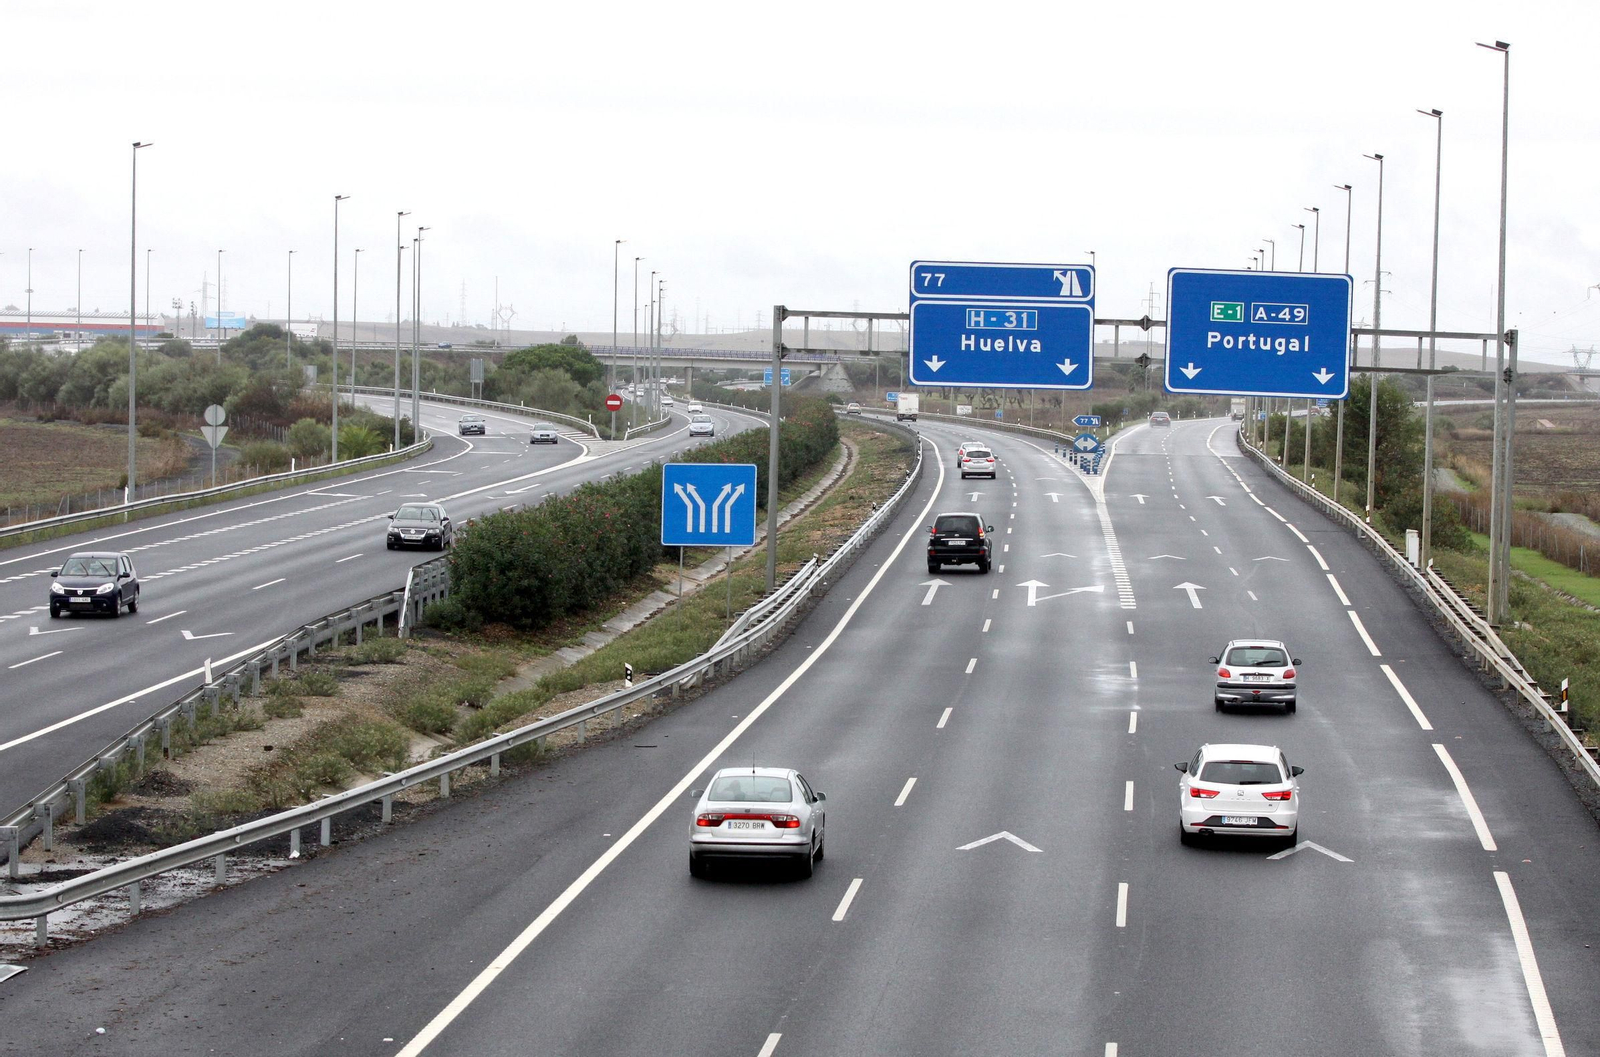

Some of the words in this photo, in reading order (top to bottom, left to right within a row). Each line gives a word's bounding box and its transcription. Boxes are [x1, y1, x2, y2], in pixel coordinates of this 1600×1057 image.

[921, 273, 946, 287] 77
[1213, 304, 1242, 319] E-1
[1254, 306, 1305, 322] A-49
[961, 334, 1042, 353] Huelva
[1207, 331, 1310, 356] Portugal
[733, 821, 750, 829] 3270
